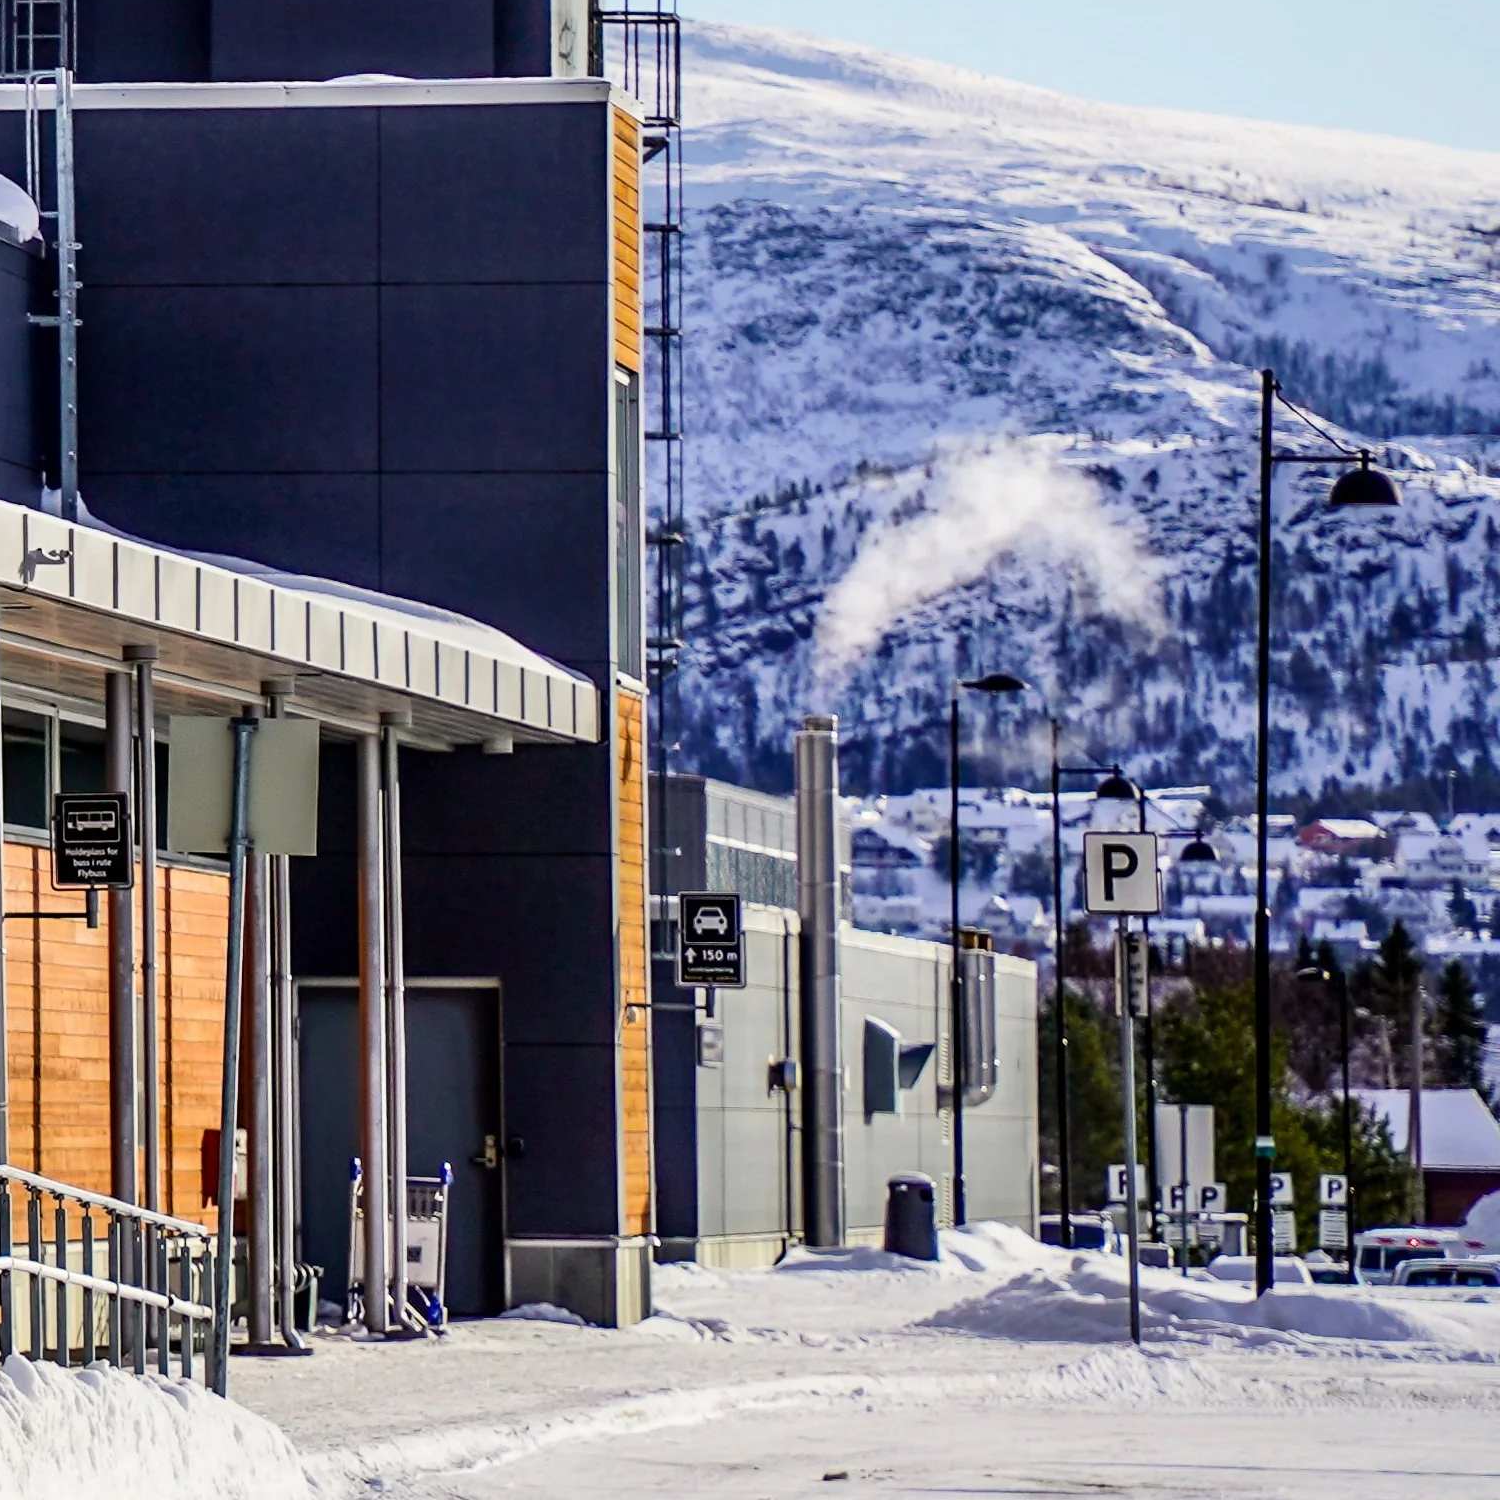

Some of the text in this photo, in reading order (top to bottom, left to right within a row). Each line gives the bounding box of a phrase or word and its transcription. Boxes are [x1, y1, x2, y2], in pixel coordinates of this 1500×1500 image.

[107, 847, 118, 856] for
[73, 859, 90, 867] buss
[96, 859, 112, 867] rute
[77, 869, 107, 879] Flybuss
[1102, 843, 1139, 901] P
[702, 949, 738, 961] 150 m
[1327, 1179, 1343, 1200] P
[1201, 1186, 1218, 1208] P
